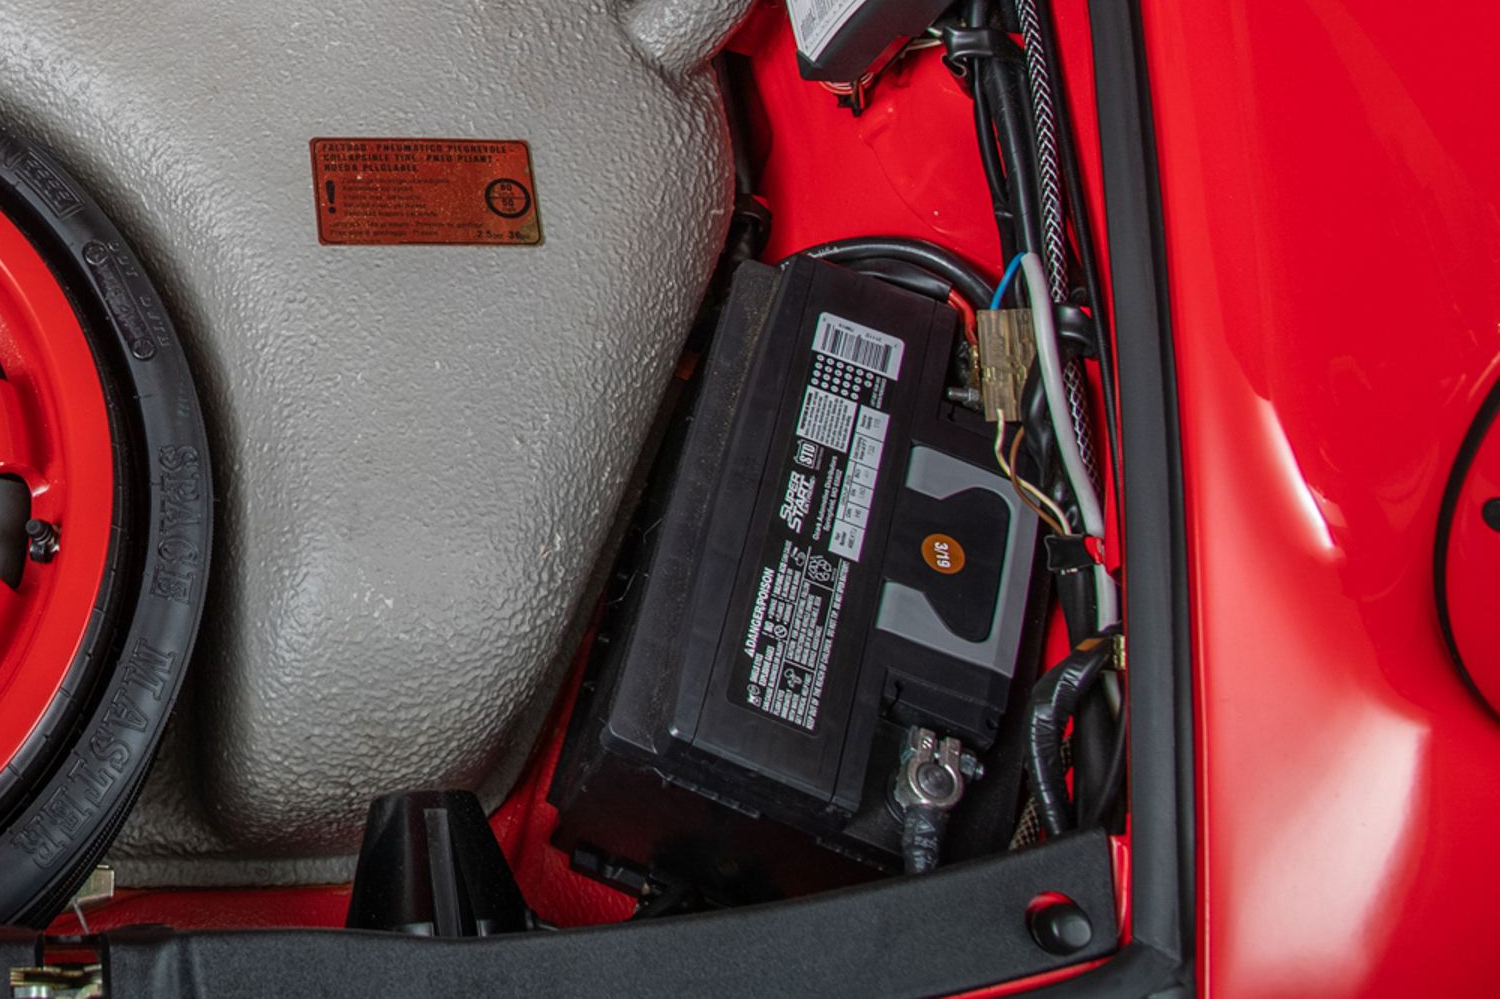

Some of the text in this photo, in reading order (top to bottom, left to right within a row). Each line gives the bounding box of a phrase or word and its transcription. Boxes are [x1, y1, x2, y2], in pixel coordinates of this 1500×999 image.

[779, 469, 801, 524] SUPER
[787, 473, 810, 533] START
[816, 489, 829, 521] Automotive
[824, 455, 837, 489] Distributors
[932, 540, 952, 570] 3/19
[10, 443, 200, 870] SPACE MASTER
